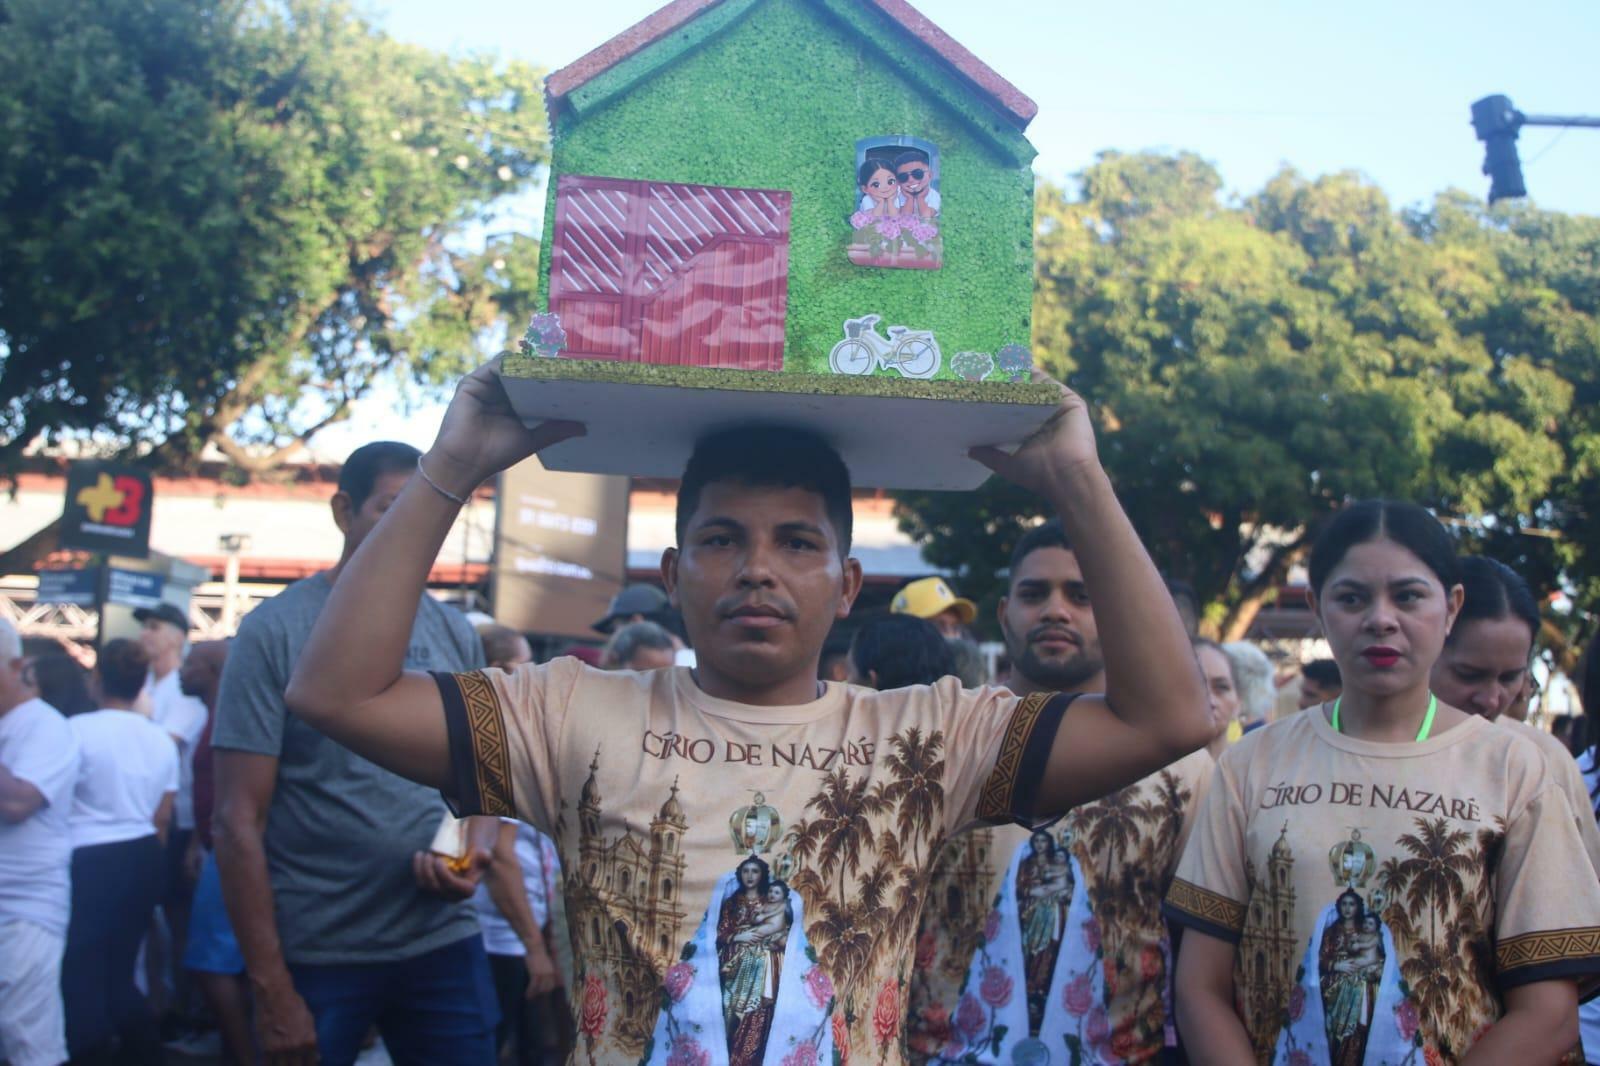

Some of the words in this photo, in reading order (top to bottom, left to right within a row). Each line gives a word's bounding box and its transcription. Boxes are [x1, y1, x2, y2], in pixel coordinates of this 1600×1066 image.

[642, 729, 715, 764] CÍRIO
[724, 740, 762, 766] DE
[771, 736, 875, 772] NAZARÉ
[1260, 781, 1323, 809] CÍRIO
[1328, 782, 1363, 806] DE
[1369, 784, 1481, 822] NAZARÉ
